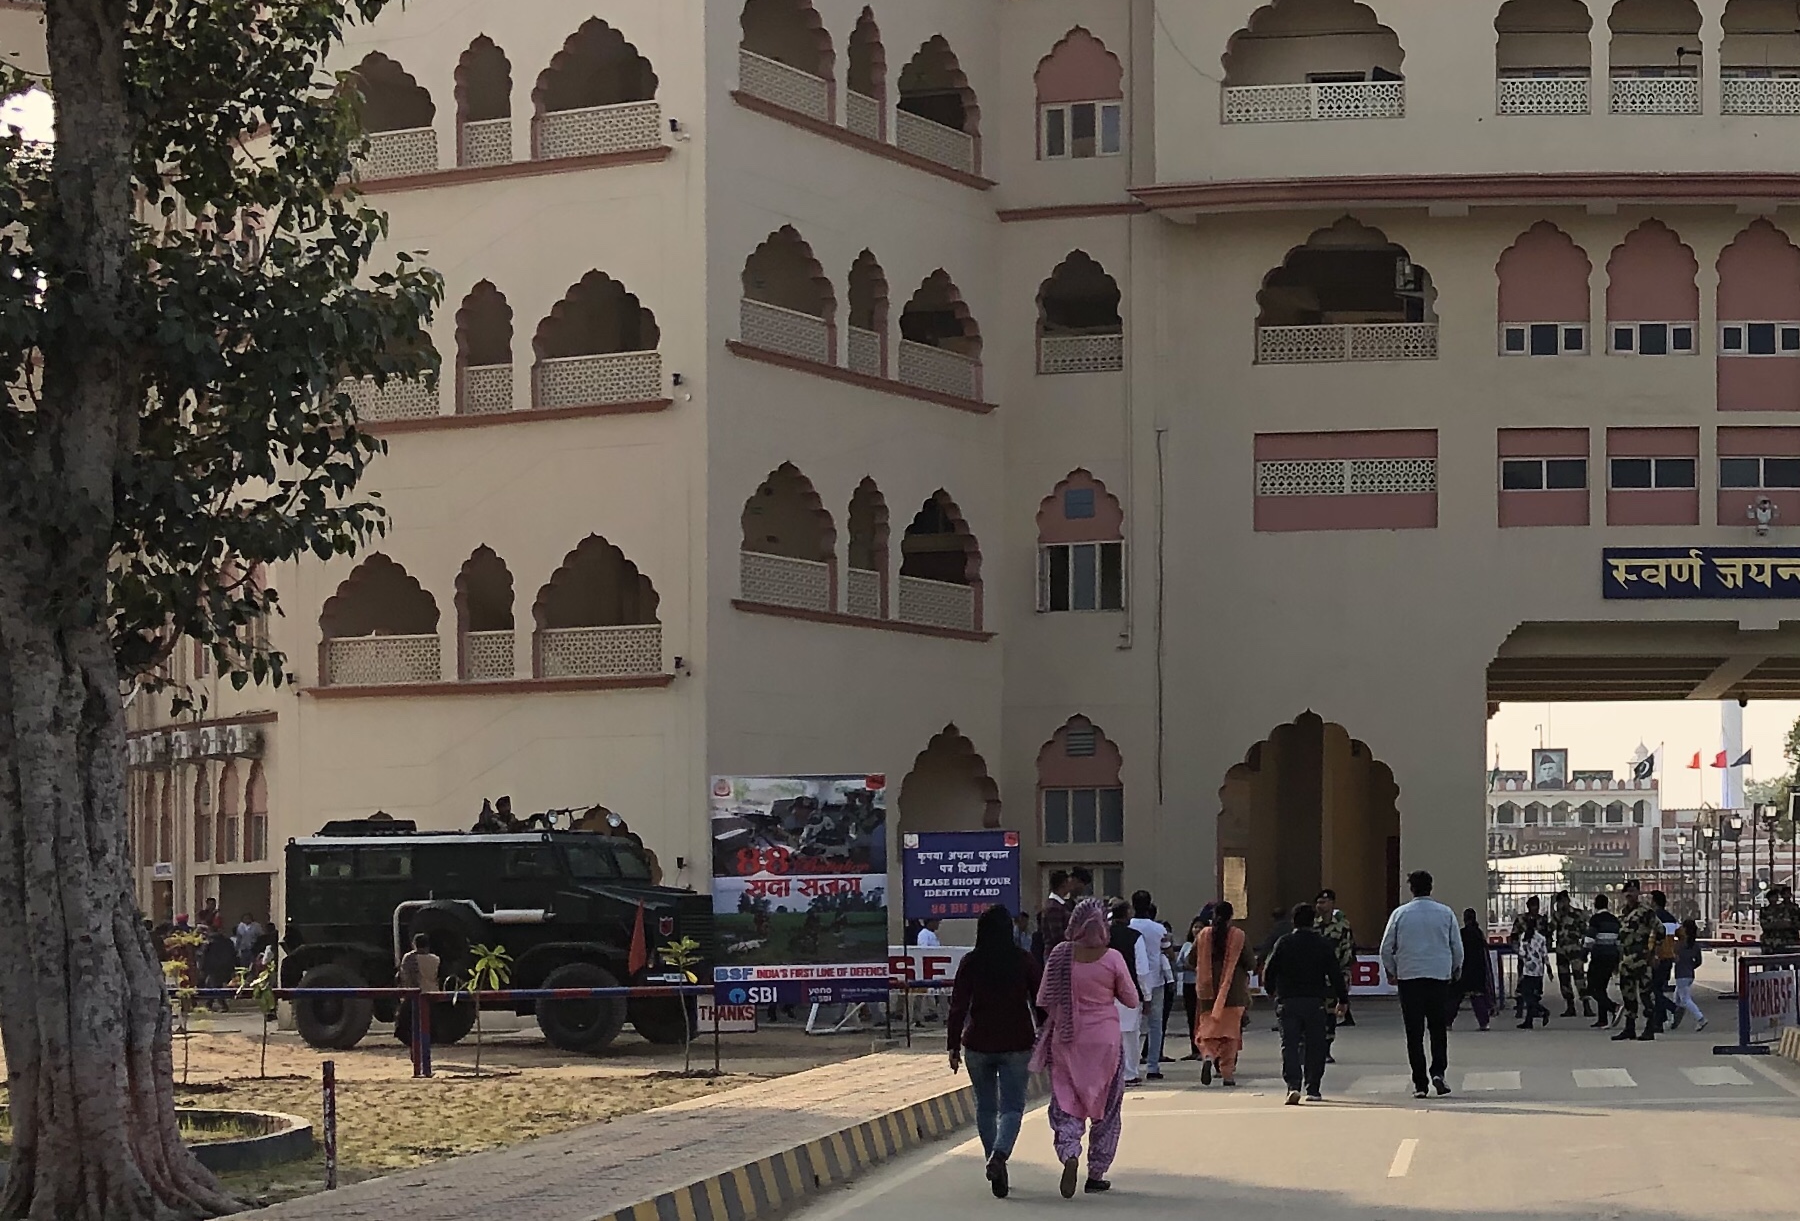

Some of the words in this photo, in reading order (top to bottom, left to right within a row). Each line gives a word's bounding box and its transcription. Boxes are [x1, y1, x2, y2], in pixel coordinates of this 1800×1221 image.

[1606, 548, 1706, 590] स्वर्ण
[736, 847, 790, 876] 88
[744, 877, 792, 898] सदा
[913, 878, 950, 886] PLEASE
[952, 878, 982, 886] SHOW
[984, 877, 1011, 885] YOUR
[924, 889, 970, 897] IDENTITY
[973, 888, 1000, 896] CARD
[715, 968, 754, 981] BSF
[757, 967, 788, 979] INDIA'S
[790, 967, 814, 978] FIRST
[816, 967, 835, 977] LINE
[837, 967, 848, 977] OF
[850, 966, 888, 977] DEFENCE
[748, 986, 778, 1003] SBI
[808, 987, 832, 995] yono
[699, 1005, 755, 1021] THANKS
